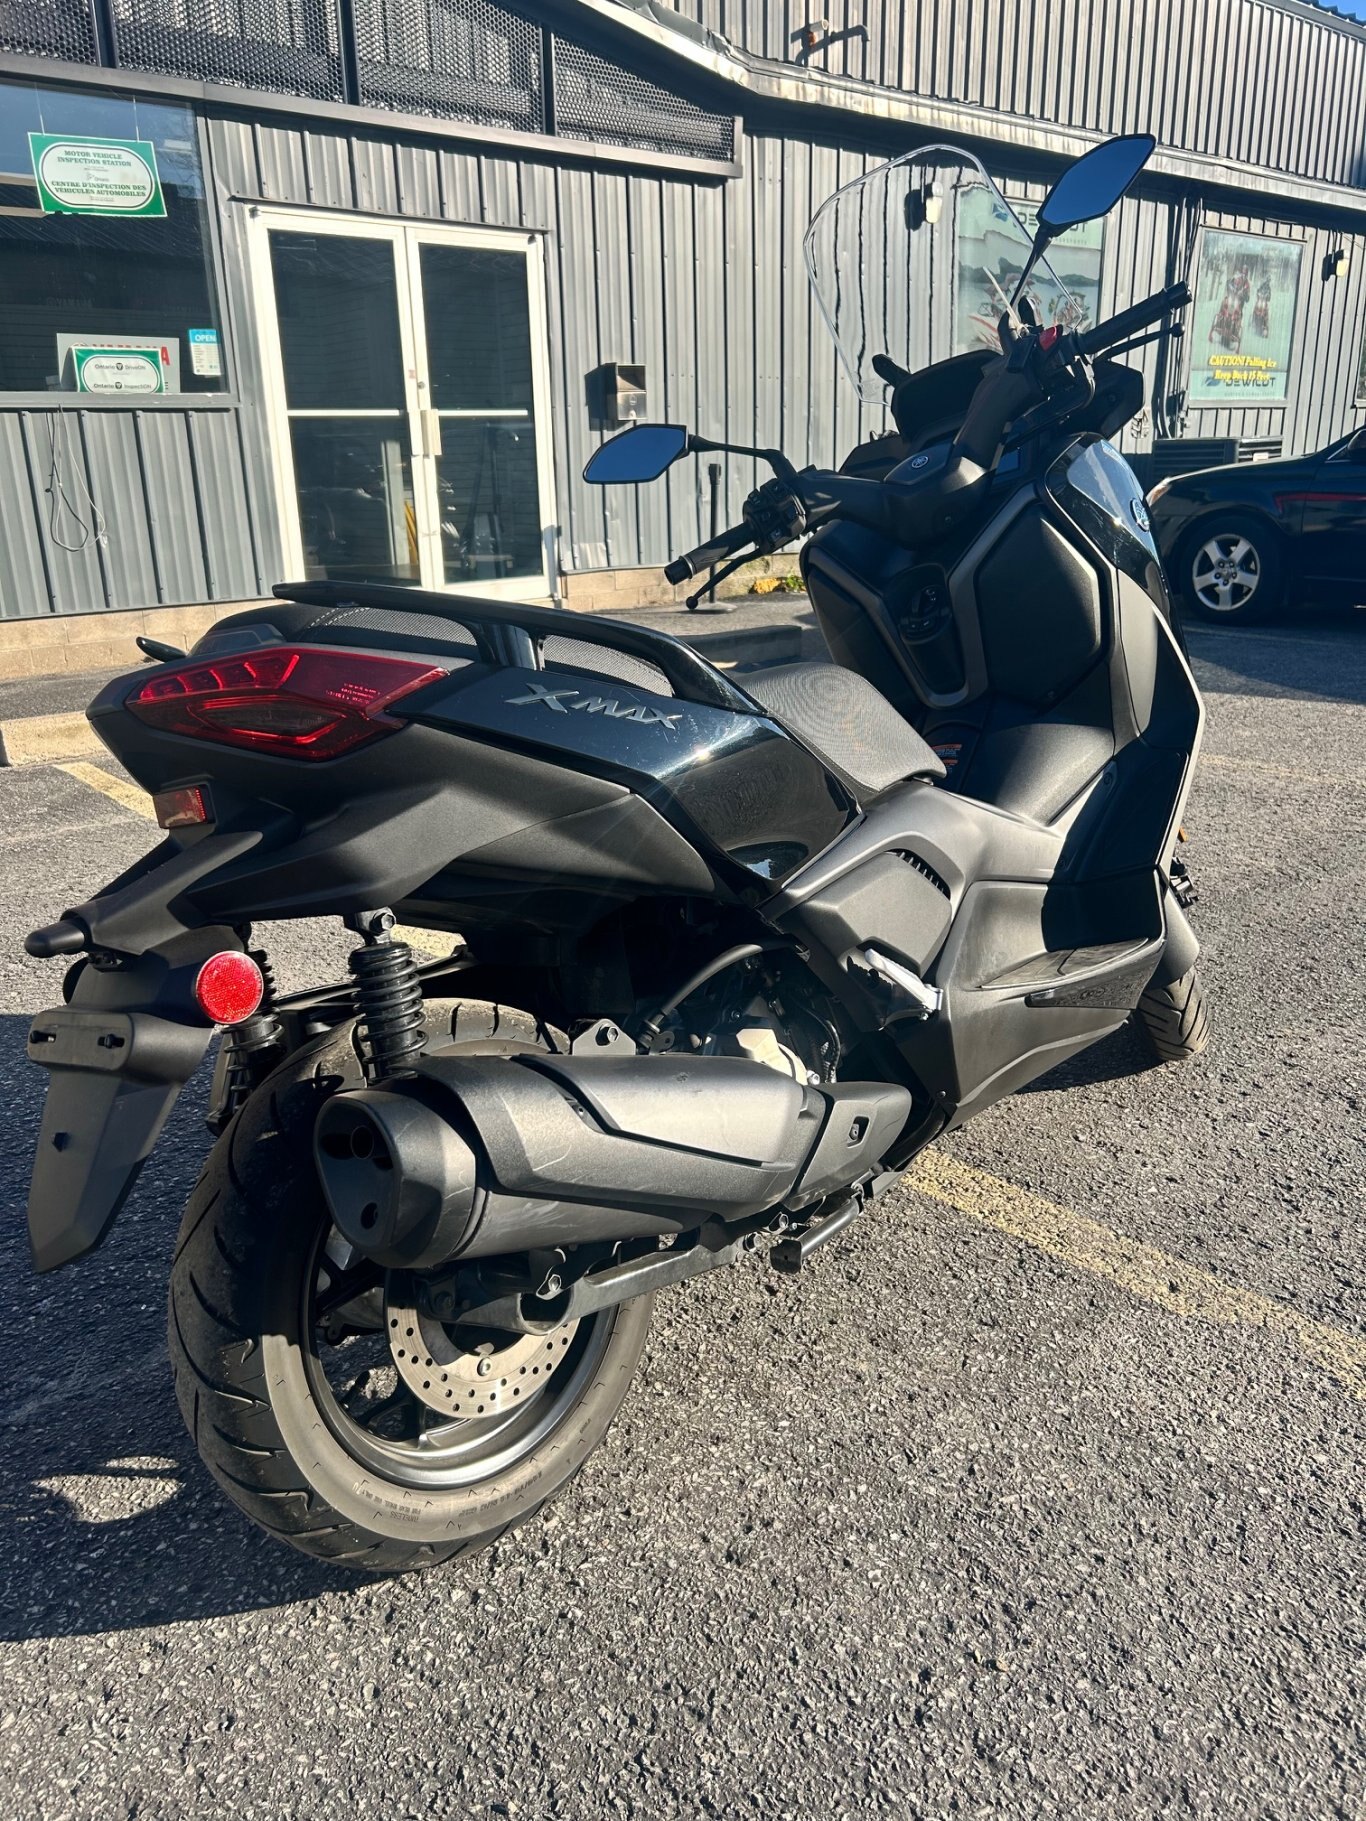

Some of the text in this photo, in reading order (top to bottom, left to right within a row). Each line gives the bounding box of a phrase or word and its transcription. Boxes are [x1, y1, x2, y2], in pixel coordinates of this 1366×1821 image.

[92, 152, 122, 160] VEHICLE
[57, 156, 132, 167] INSPECTION STATION
[81, 182, 131, 190] D'INSPECTION
[97, 189, 147, 197] AUTOMOBILES
